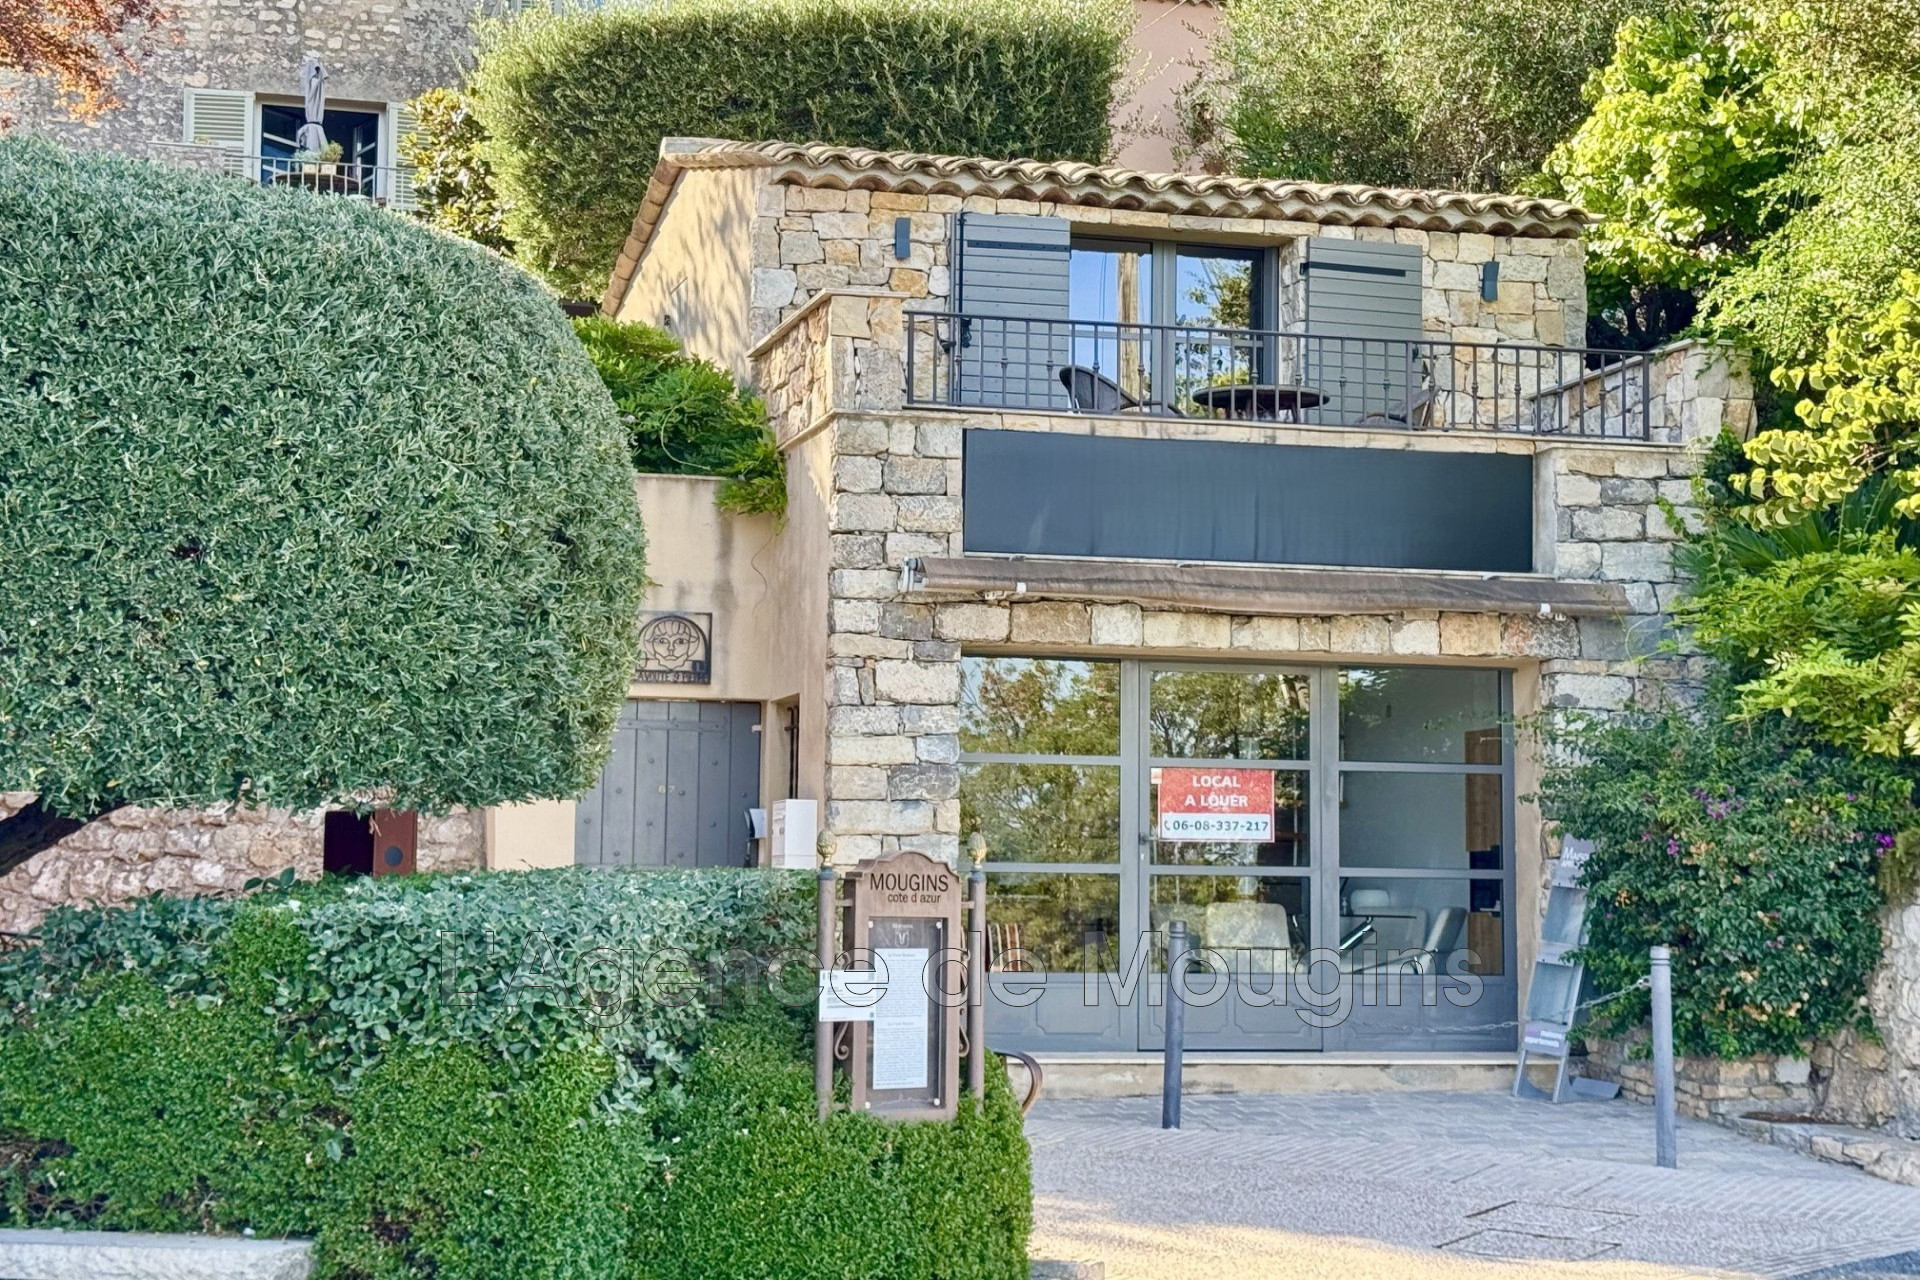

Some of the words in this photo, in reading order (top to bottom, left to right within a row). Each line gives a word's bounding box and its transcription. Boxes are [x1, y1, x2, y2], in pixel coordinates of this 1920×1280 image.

[1192, 775, 1241, 788] LOCAL
[1184, 794, 1196, 807] A
[1200, 794, 1249, 807] LOUER
[1172, 820, 1269, 831] 06-08-337-217
[870, 873, 949, 892] MOUGINS
[887, 893, 908, 903] cote
[920, 895, 941, 903] azur
